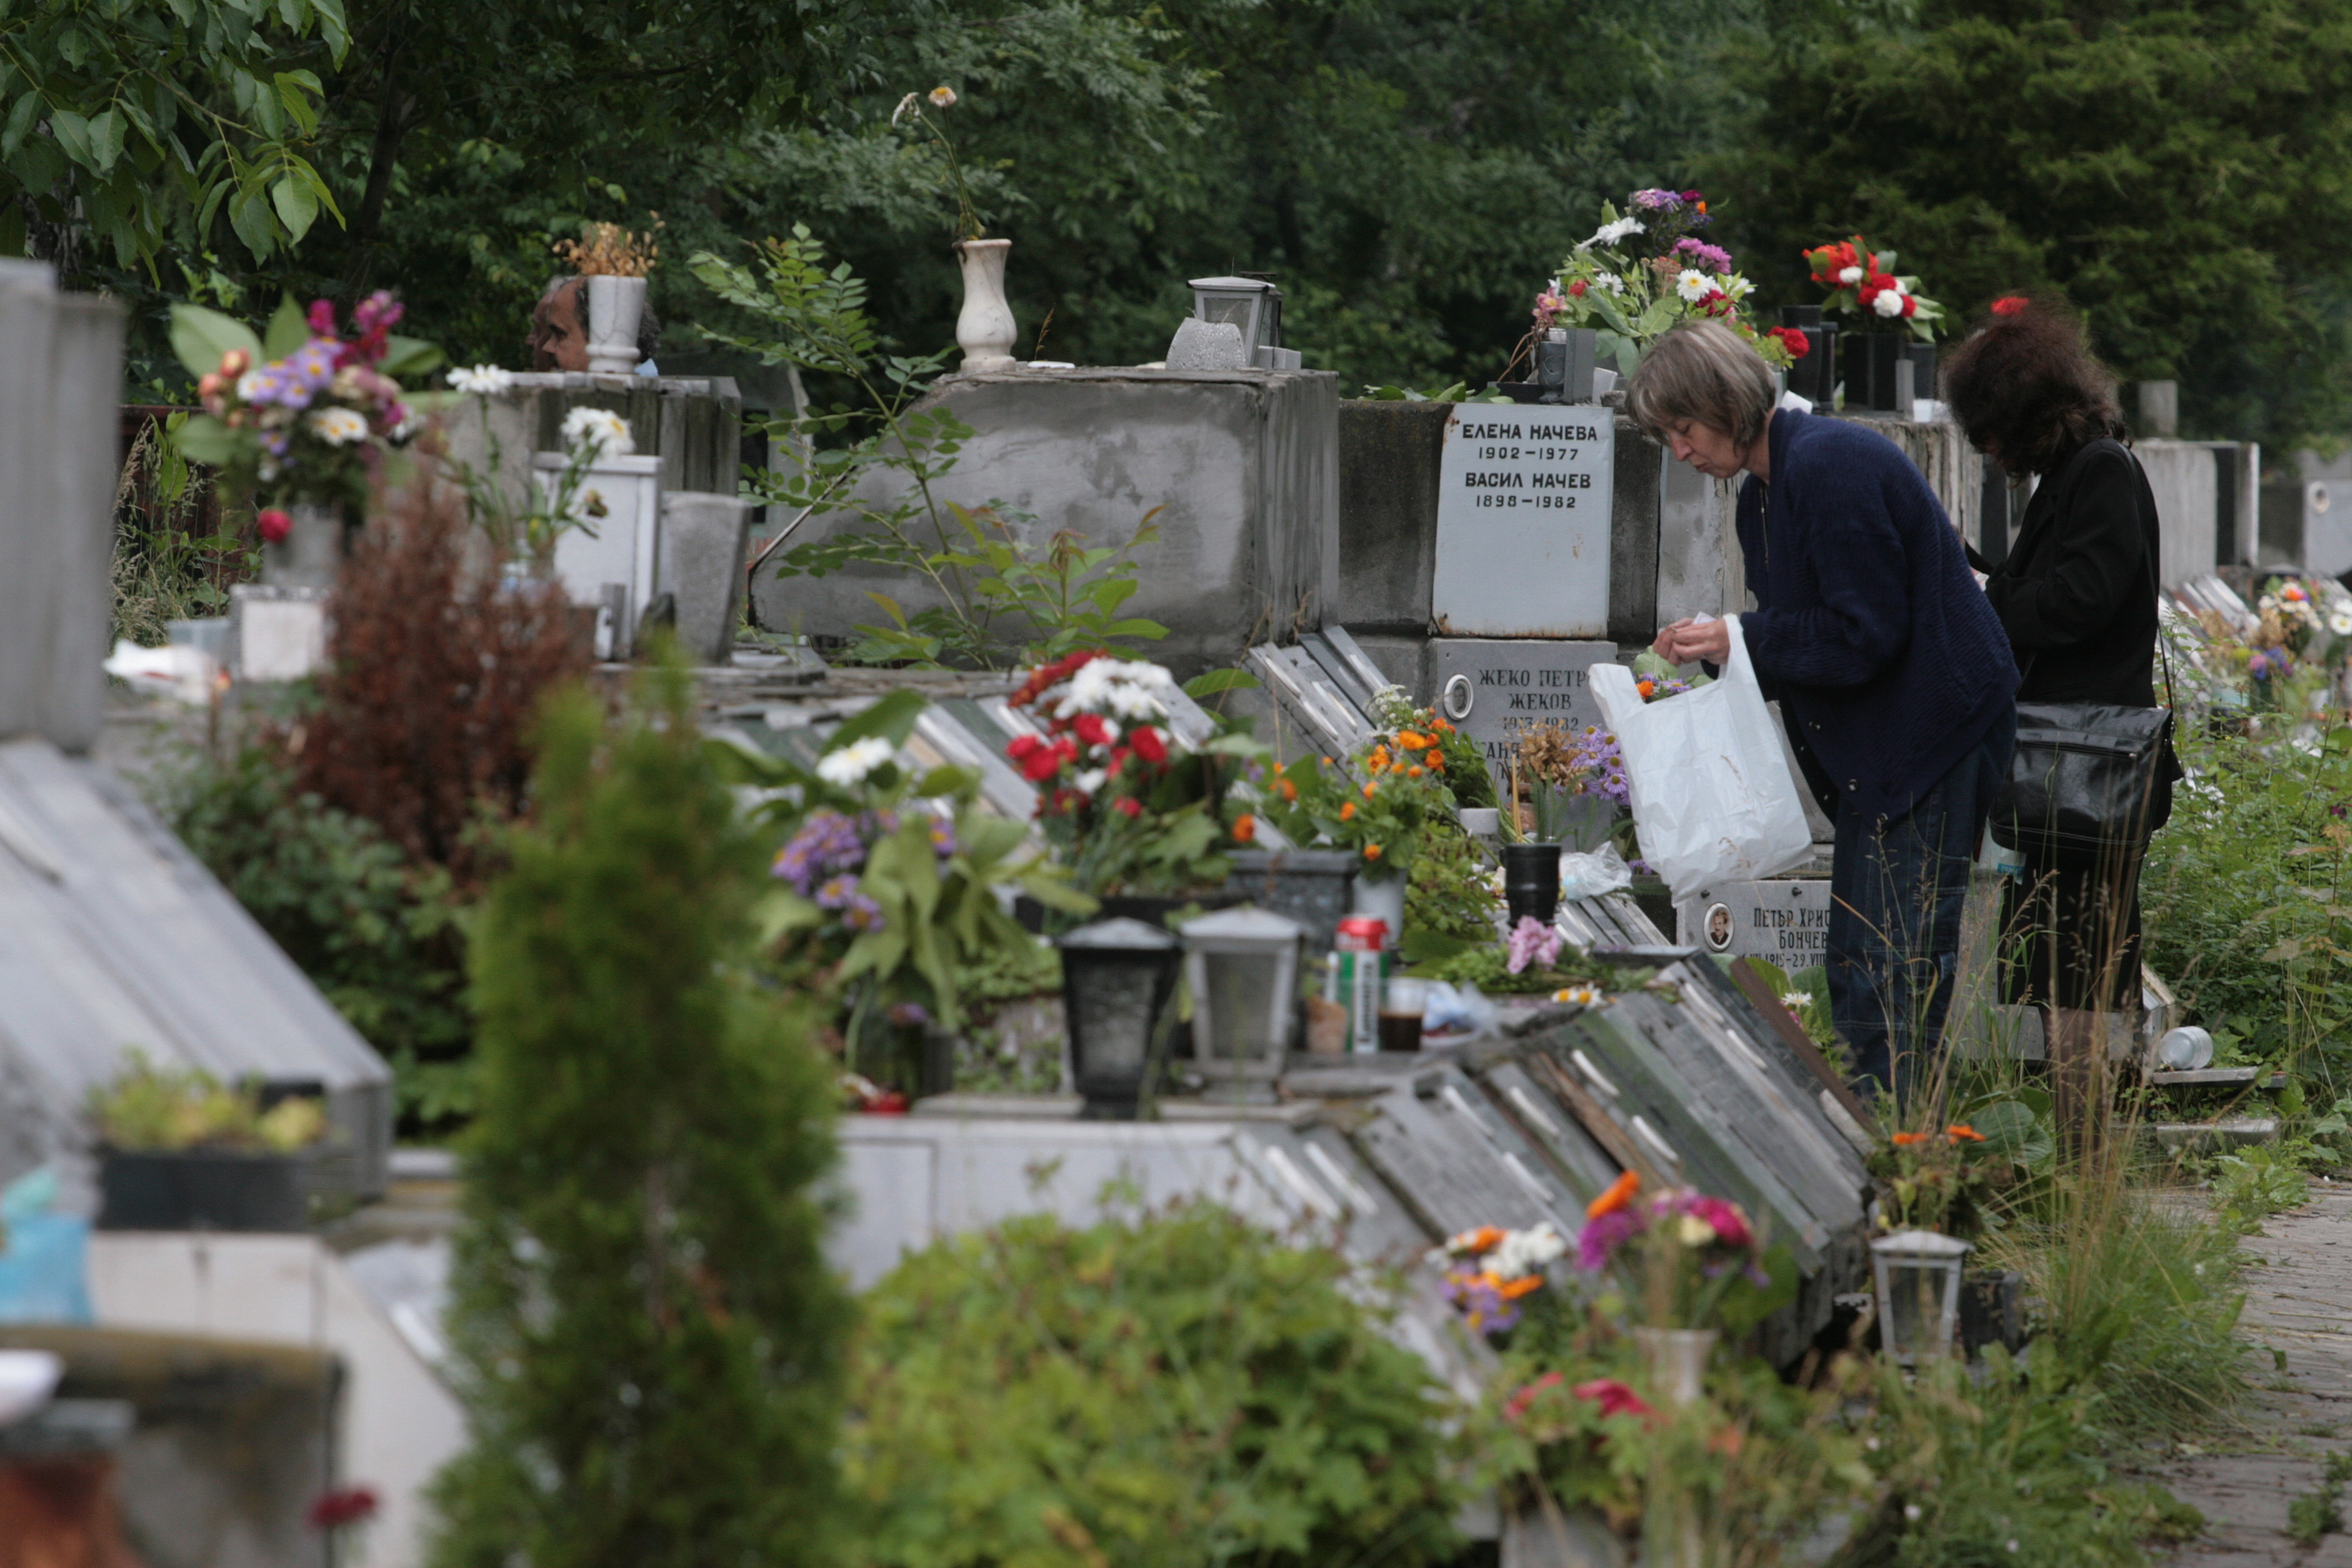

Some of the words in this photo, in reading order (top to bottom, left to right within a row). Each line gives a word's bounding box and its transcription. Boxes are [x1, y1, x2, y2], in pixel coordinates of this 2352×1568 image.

[1463, 424, 1522, 439] ЕЛЕНА
[1530, 424, 1598, 440] НАЧЕВА
[1465, 472, 1523, 487] ВАСИЛ
[1532, 473, 1591, 489] НАЧЕВ
[1479, 669, 1530, 687] ЖЕКО
[1539, 670, 1590, 687] ПЕТР
[1509, 693, 1571, 710] ЖЕКОВ
[1754, 908, 1794, 927] ПЕТЪР
